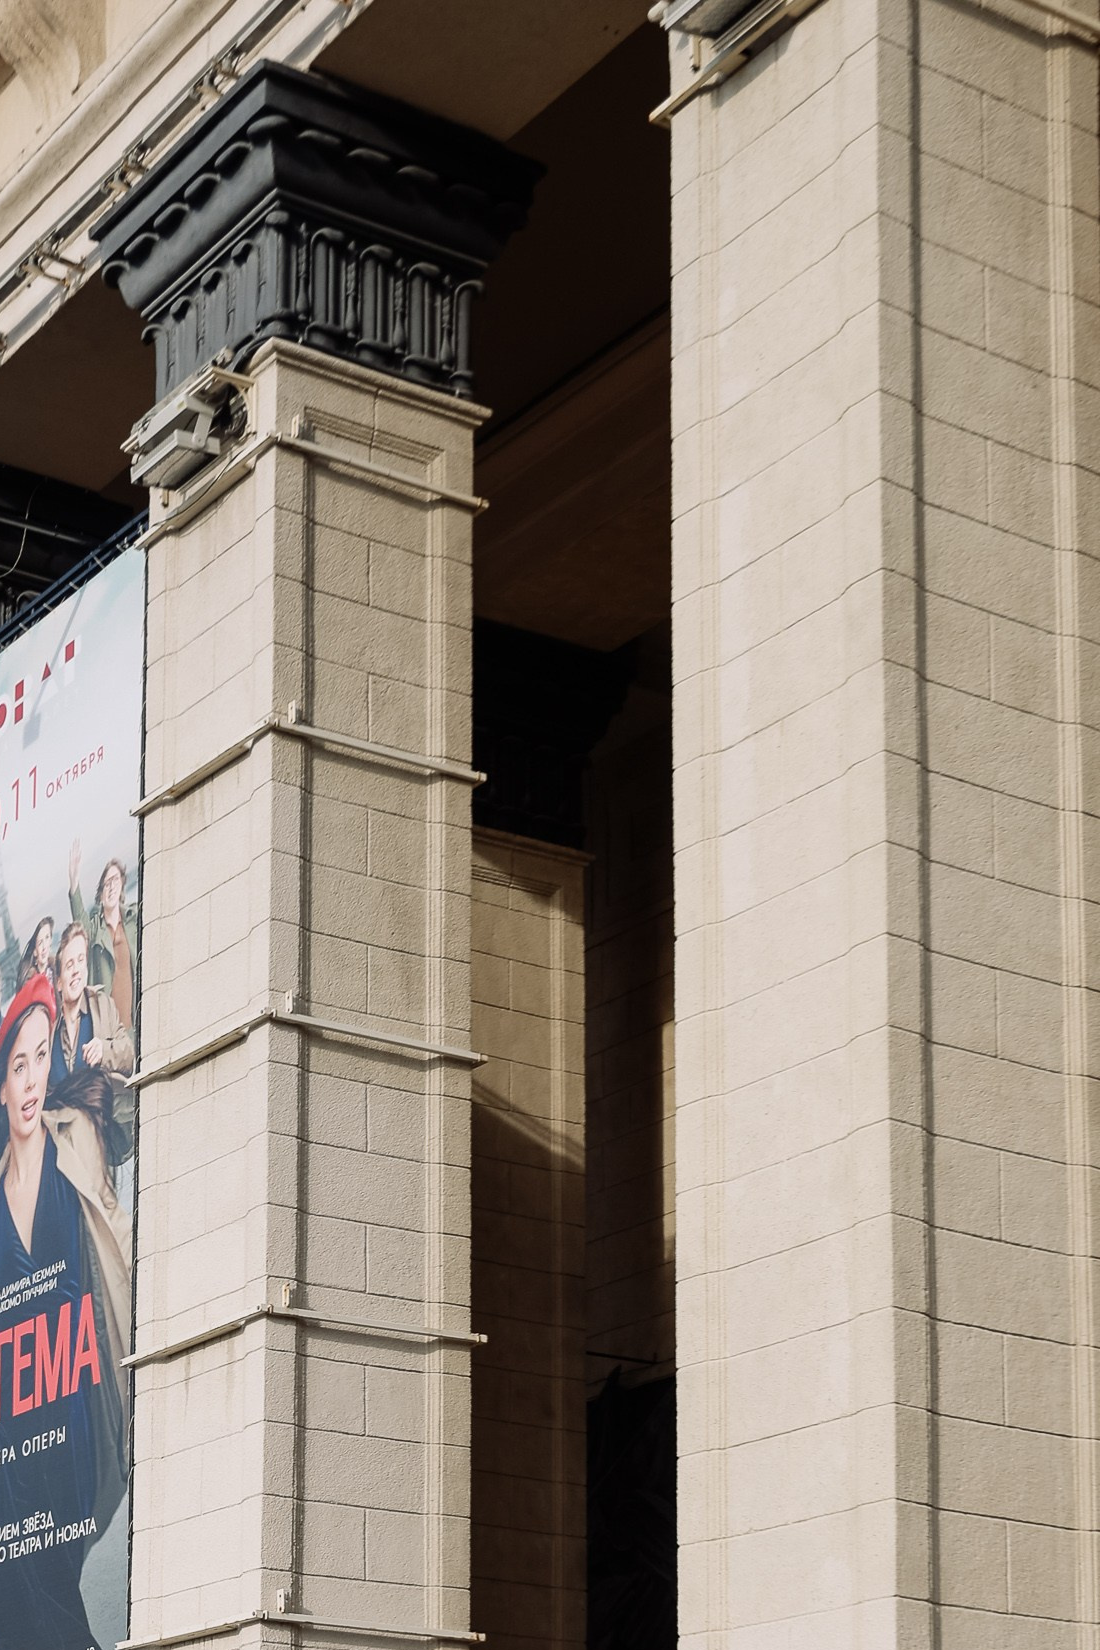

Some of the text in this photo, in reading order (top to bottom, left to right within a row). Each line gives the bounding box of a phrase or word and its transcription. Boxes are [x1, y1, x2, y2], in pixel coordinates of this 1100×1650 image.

[46, 745, 104, 799] ОКТЯБРЯ
[31, 1259, 67, 1285] КЕХМАНА
[22, 1276, 58, 1304] ПУЧЧИНИ
[21, 1425, 66, 1457] ОПЕРЫ
[22, 1510, 55, 1535] ЗВЁЗД
[8, 1535, 42, 1560] ТЕАТРА
[44, 1532, 54, 1549] И
[56, 1516, 97, 1545] НОВАТА
